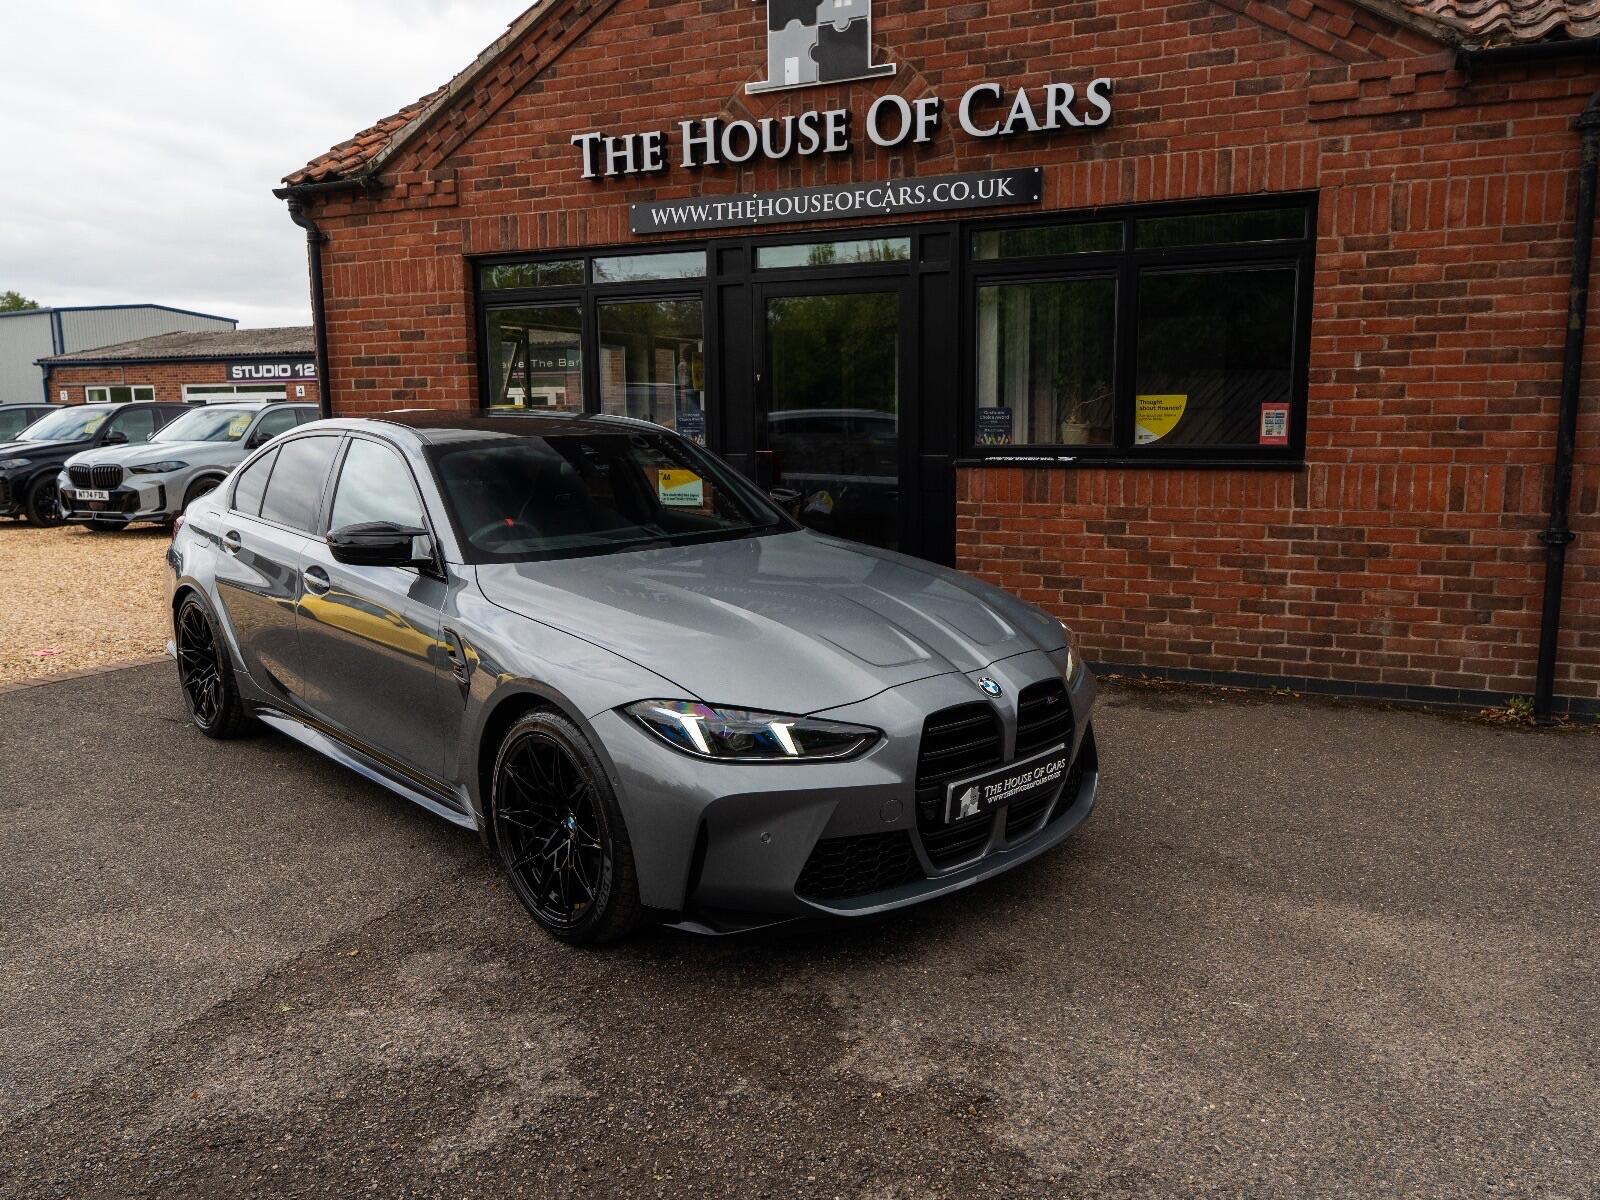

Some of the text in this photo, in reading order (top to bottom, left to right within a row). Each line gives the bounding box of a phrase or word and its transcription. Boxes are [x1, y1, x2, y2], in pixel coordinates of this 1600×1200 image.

[570, 77, 1112, 179] THE HOUSE OF CARS
[650, 176, 1015, 226] WWW.THEHOUSEOFCARS.CO.UK
[232, 364, 292, 378] STUDIO
[984, 758, 1066, 797] THE HOUSE OF CARS
